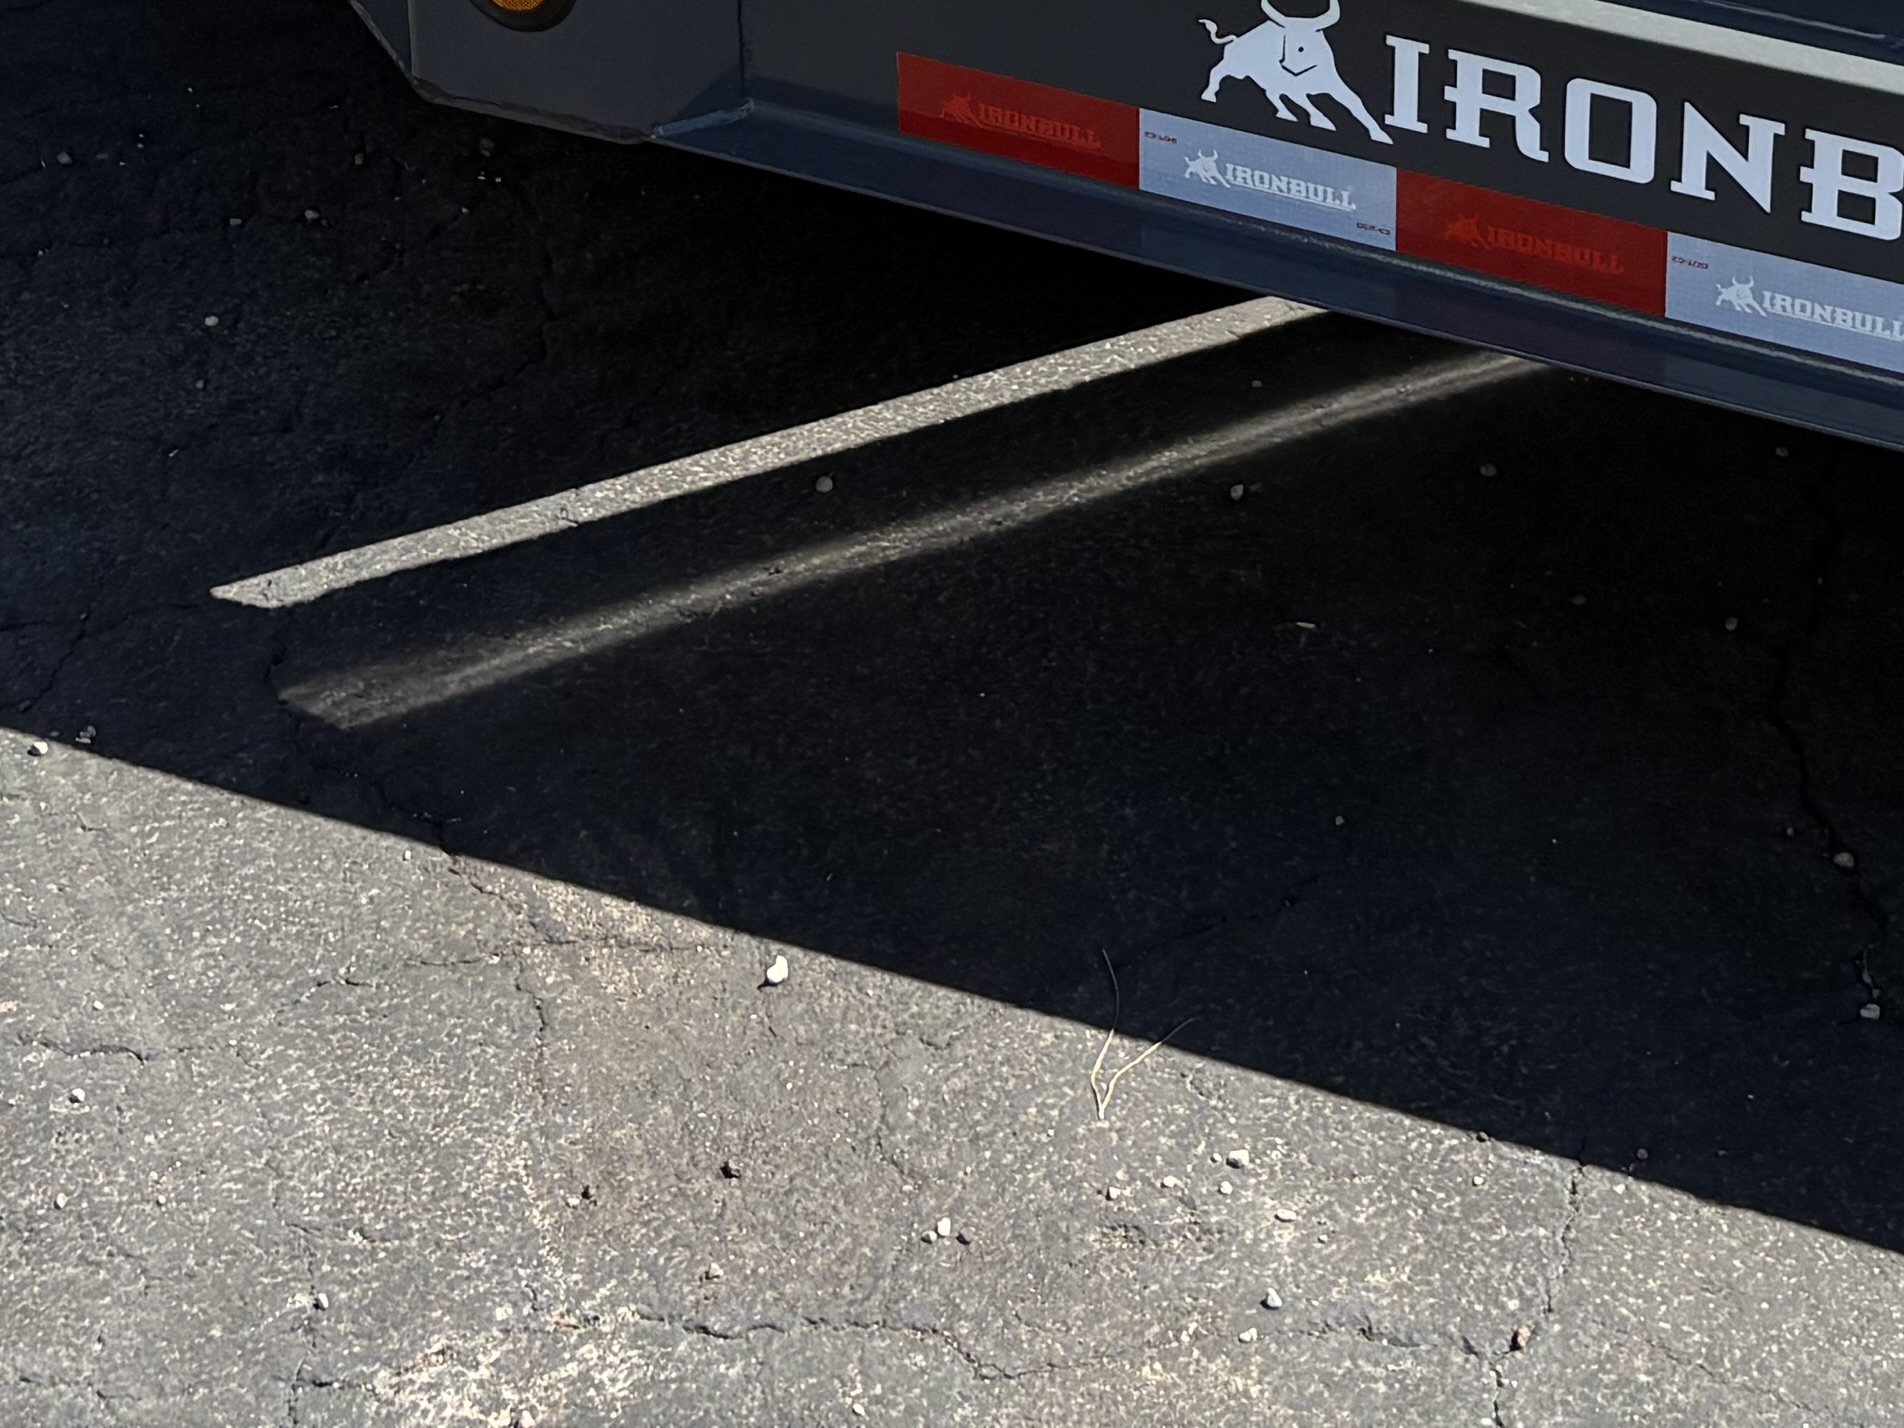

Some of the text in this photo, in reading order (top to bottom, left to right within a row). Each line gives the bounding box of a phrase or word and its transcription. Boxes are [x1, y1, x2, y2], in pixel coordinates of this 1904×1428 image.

[979, 103, 1102, 150] IRONBULL
[1225, 163, 1356, 211] IRONBULL
[1487, 225, 1625, 275] IRONBULL
